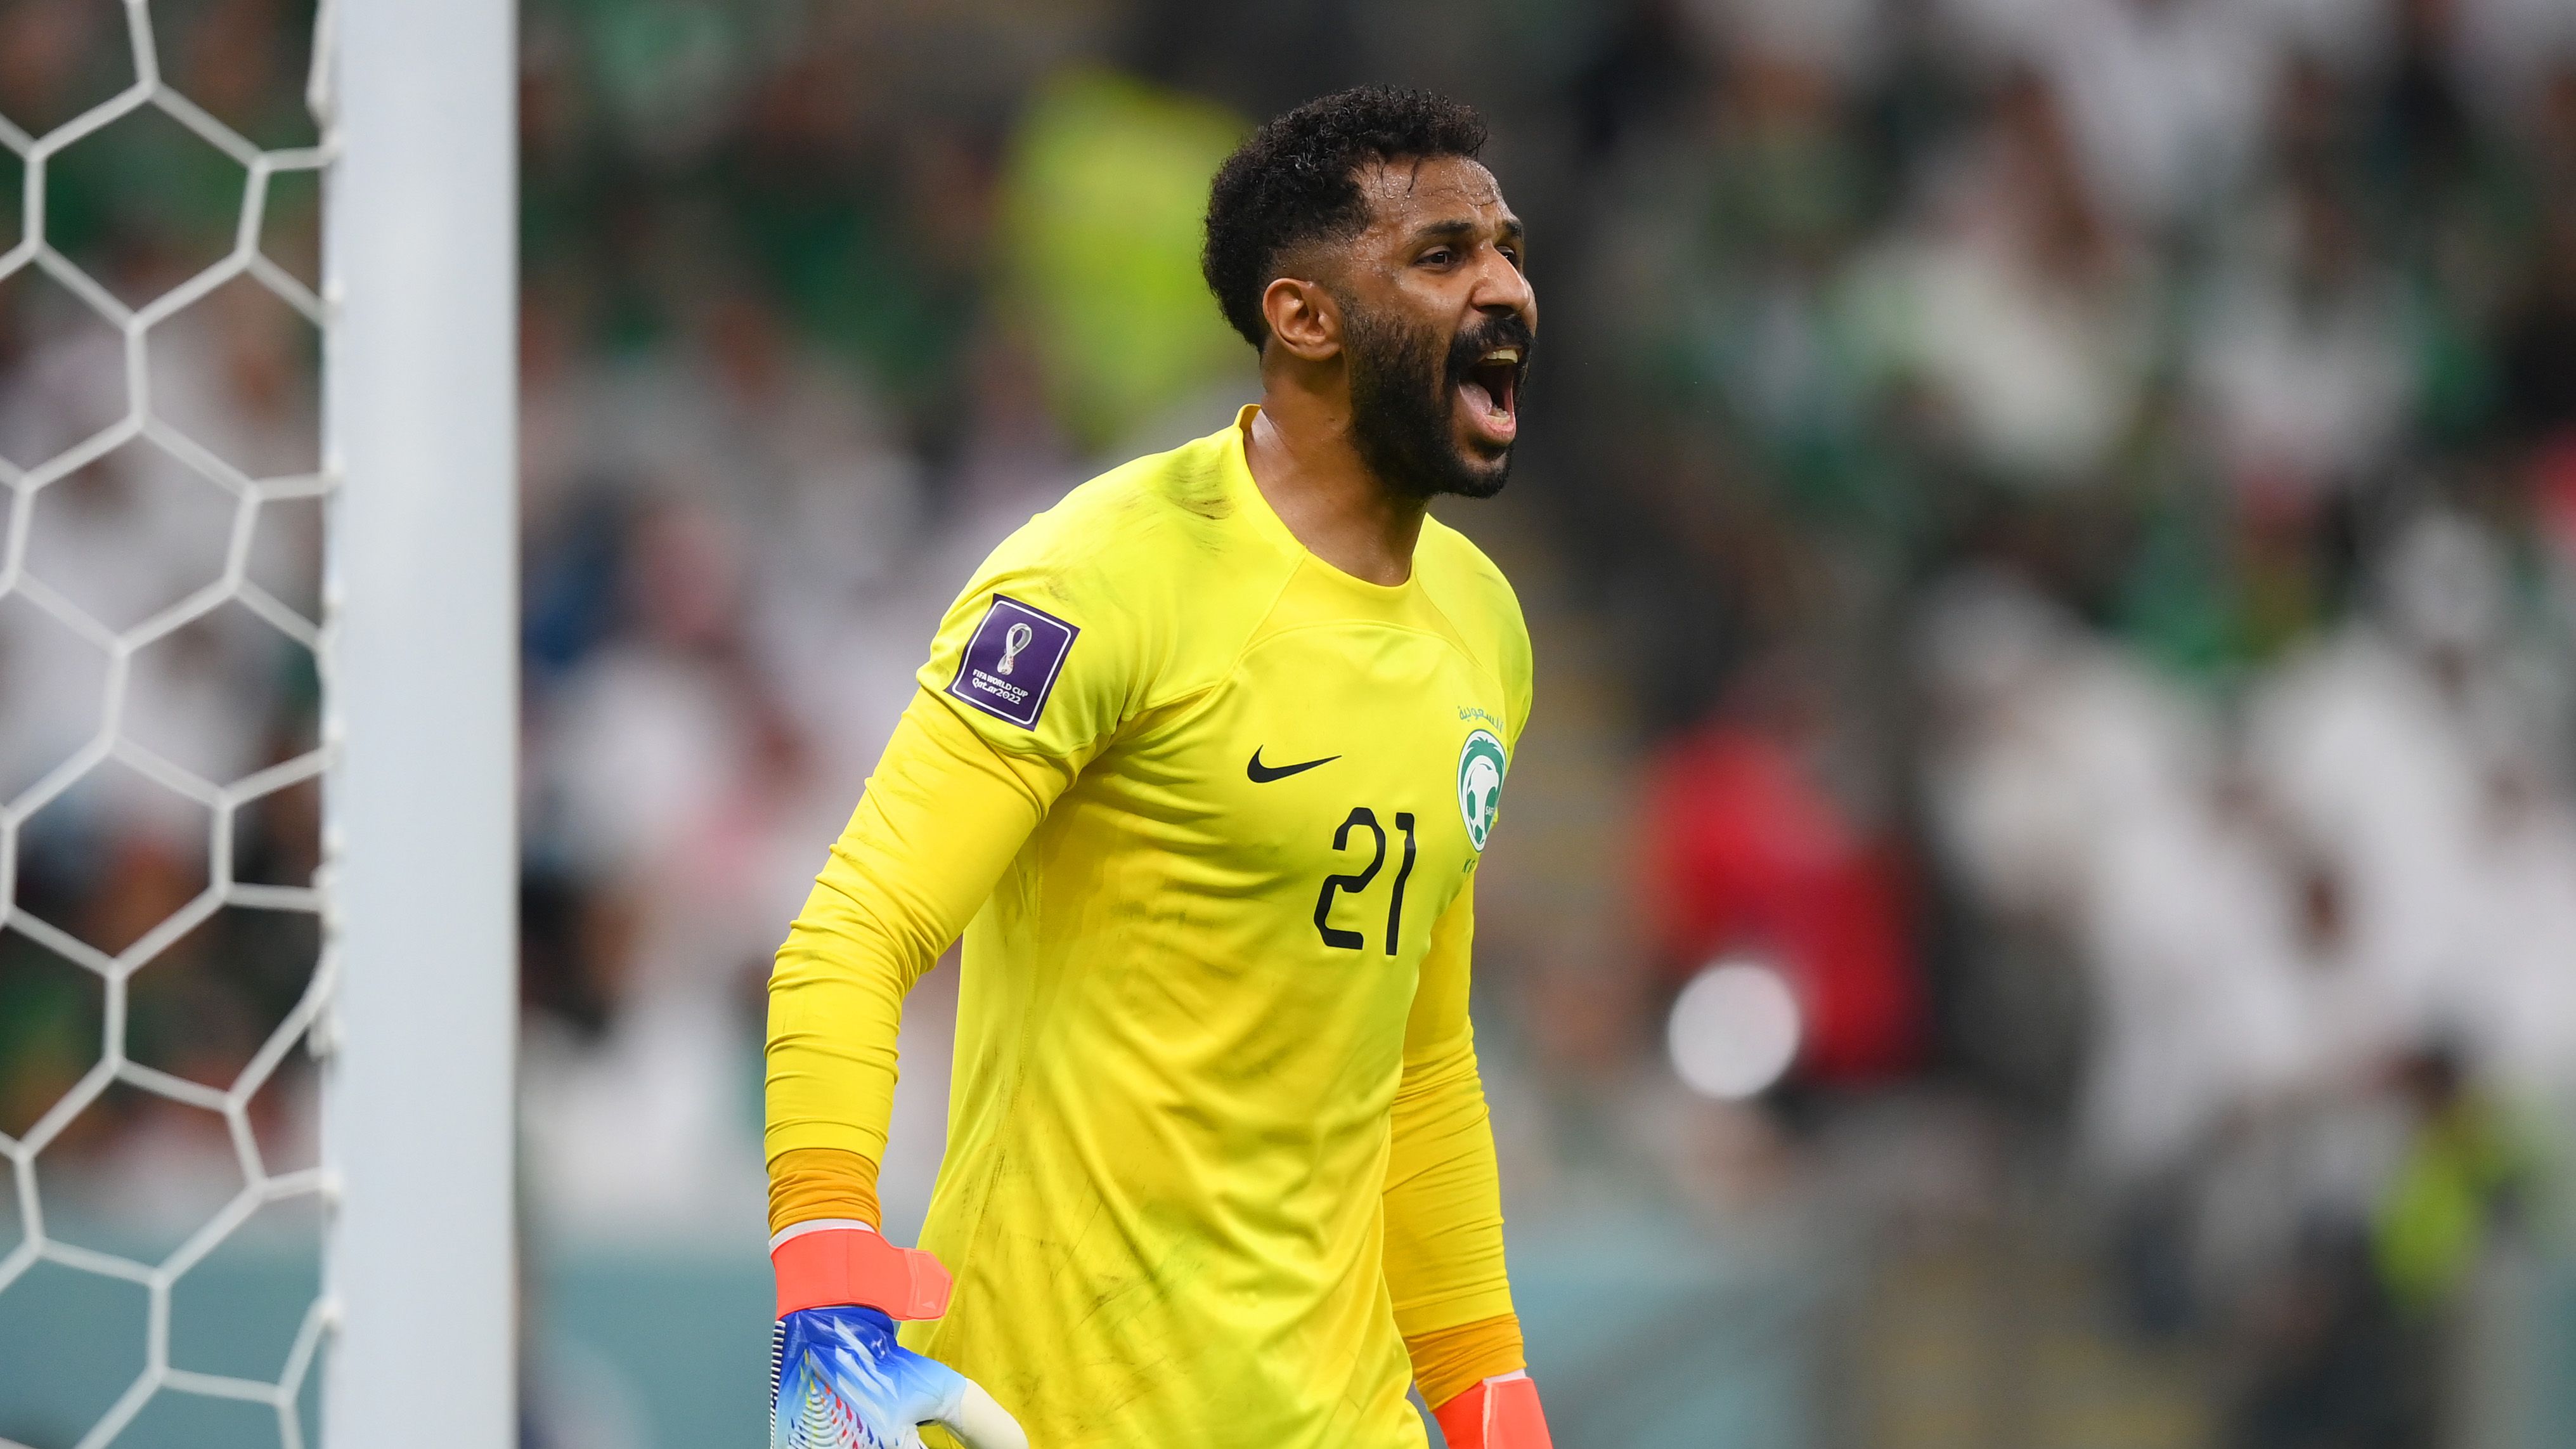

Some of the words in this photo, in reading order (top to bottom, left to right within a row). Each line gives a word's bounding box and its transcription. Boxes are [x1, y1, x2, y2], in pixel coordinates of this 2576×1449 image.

[973, 669, 987, 680] FIFA
[987, 675, 1012, 691] WORLD
[1012, 687, 1028, 698] CUP
[1314, 807, 1416, 956] 21
